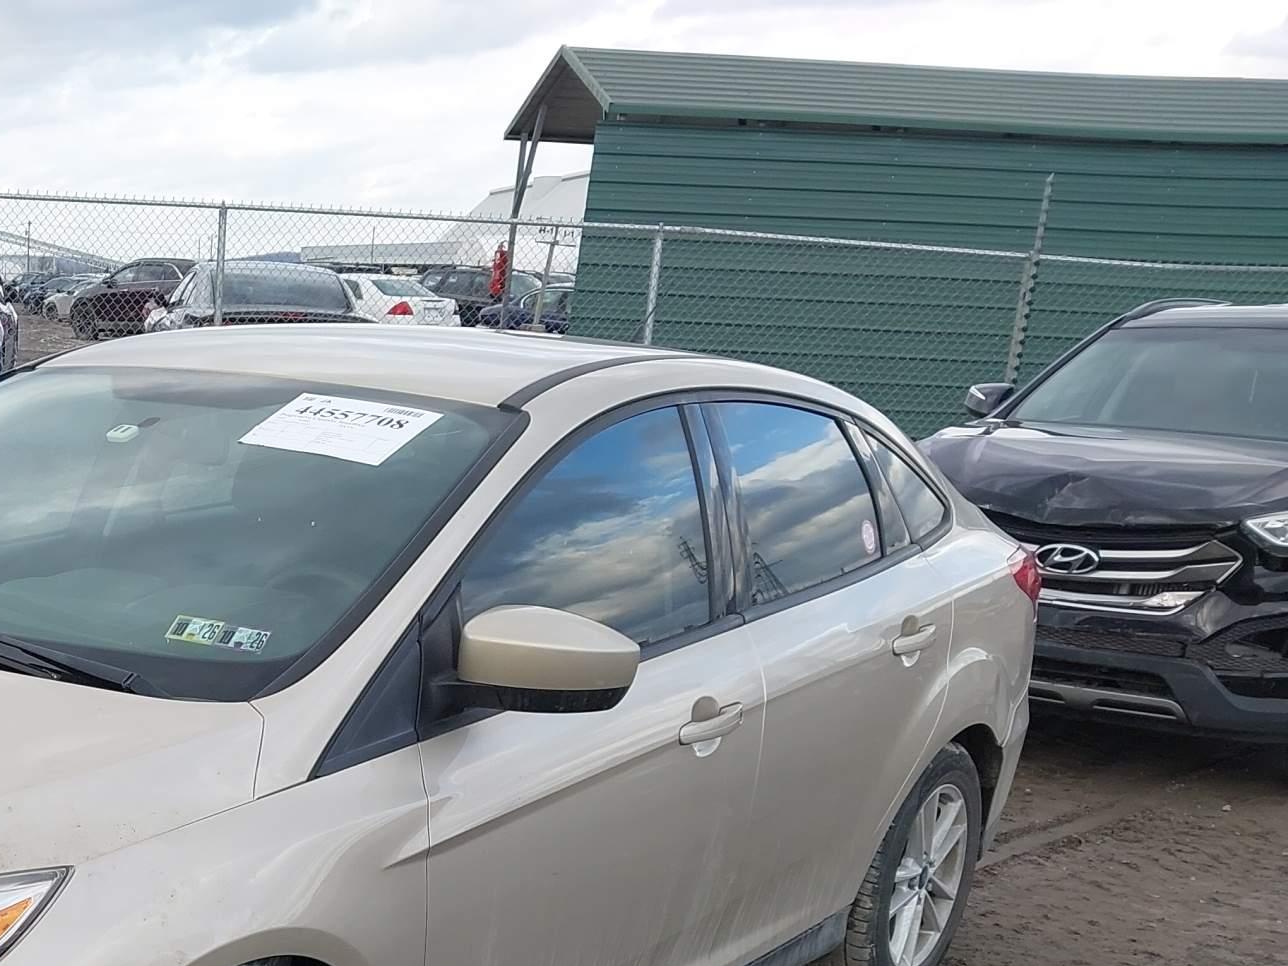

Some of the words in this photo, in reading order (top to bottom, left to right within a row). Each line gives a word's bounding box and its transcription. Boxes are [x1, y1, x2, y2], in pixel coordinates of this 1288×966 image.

[295, 405, 409, 430] 44557708
[172, 622, 189, 636] 10
[201, 623, 220, 641] 26
[249, 632, 268, 650] 26
